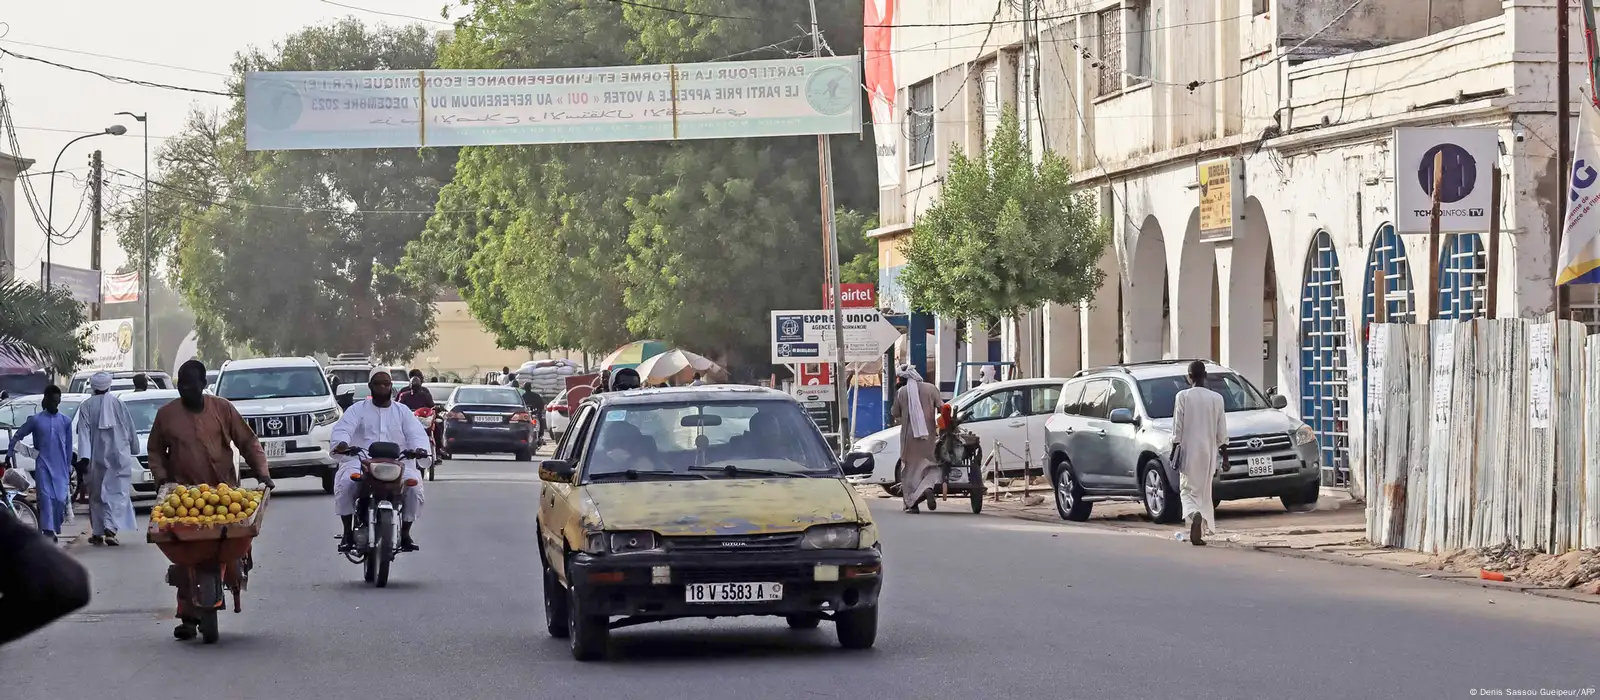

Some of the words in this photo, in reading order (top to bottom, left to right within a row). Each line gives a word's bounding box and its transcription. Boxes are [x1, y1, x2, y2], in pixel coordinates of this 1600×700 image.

[841, 288, 872, 301] airtel
[803, 314, 844, 323] EXPRE
[846, 313, 879, 323] UNION
[690, 585, 704, 600] 18
[708, 585, 717, 600] V
[721, 584, 752, 600] 5583
[756, 584, 764, 600] A
